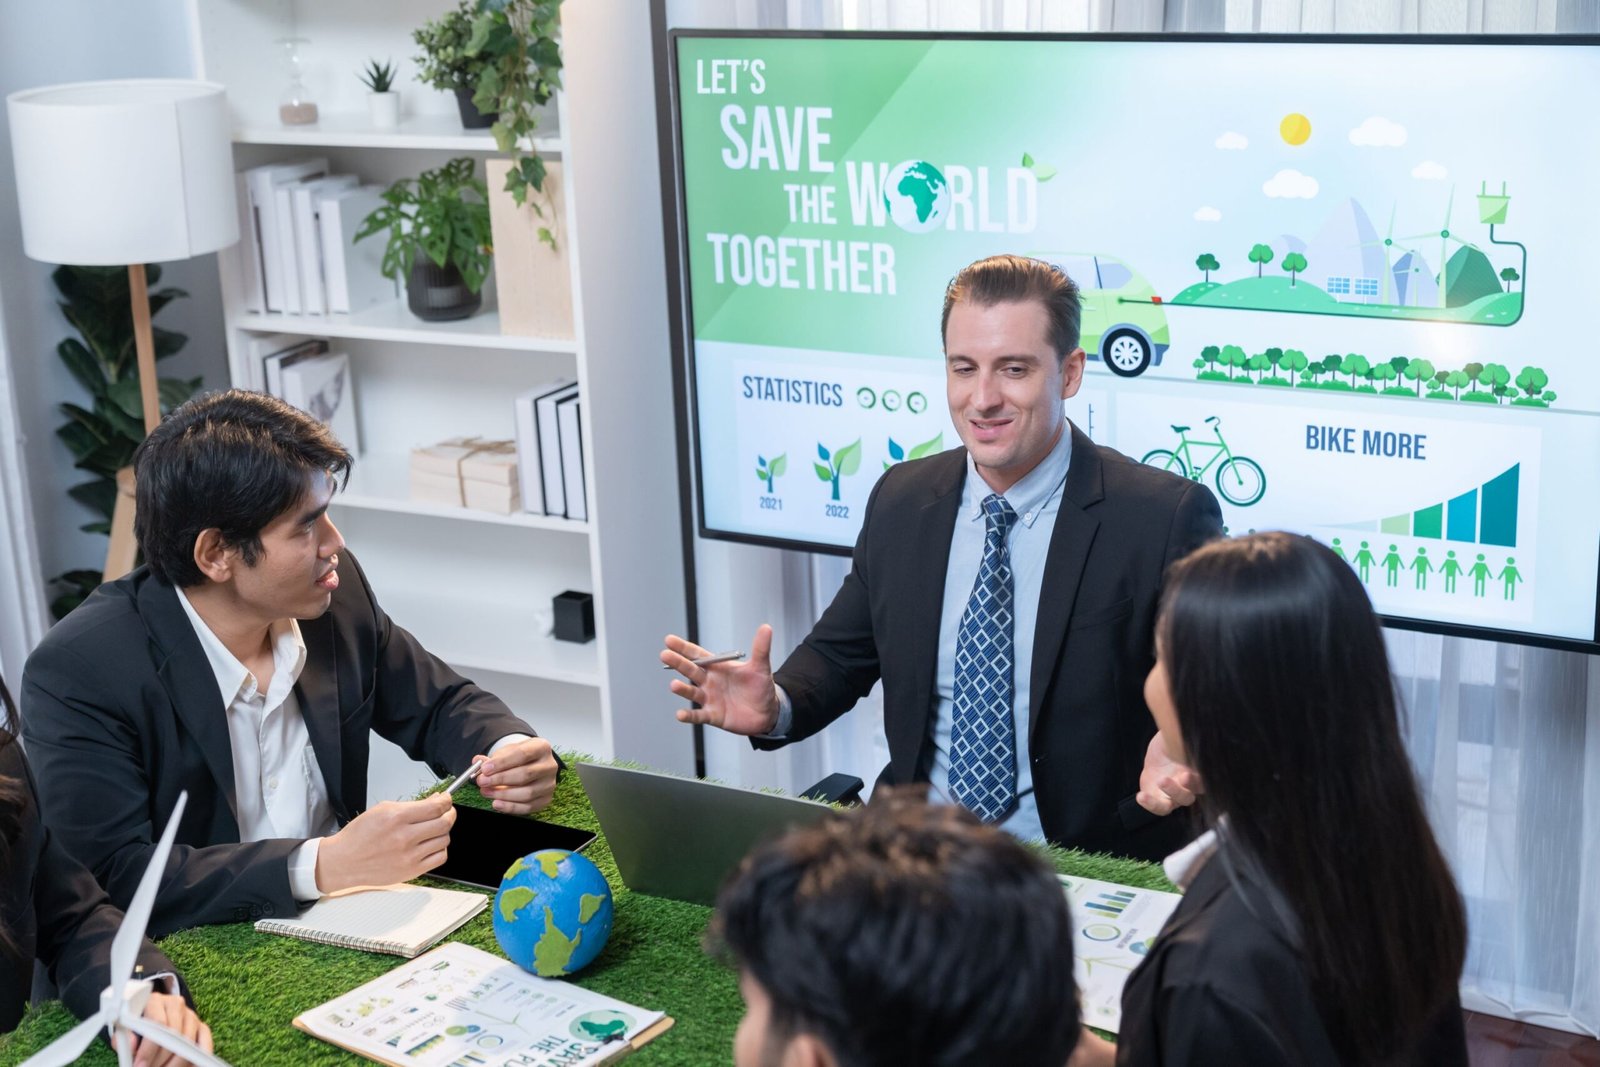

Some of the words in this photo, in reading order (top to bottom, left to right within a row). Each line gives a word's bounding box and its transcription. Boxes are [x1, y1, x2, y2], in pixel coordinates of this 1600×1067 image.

[696, 59, 766, 94] LET’S
[720, 104, 834, 173] SAVE
[783, 183, 837, 225] THE
[706, 232, 897, 296] TOGETHER
[743, 375, 843, 407] STATISTICS
[1306, 424, 1355, 454] BIKE
[1362, 430, 1427, 461] MORE
[760, 496, 783, 511] 2021
[825, 504, 850, 519] 2022
[529, 1035, 569, 1055] THE
